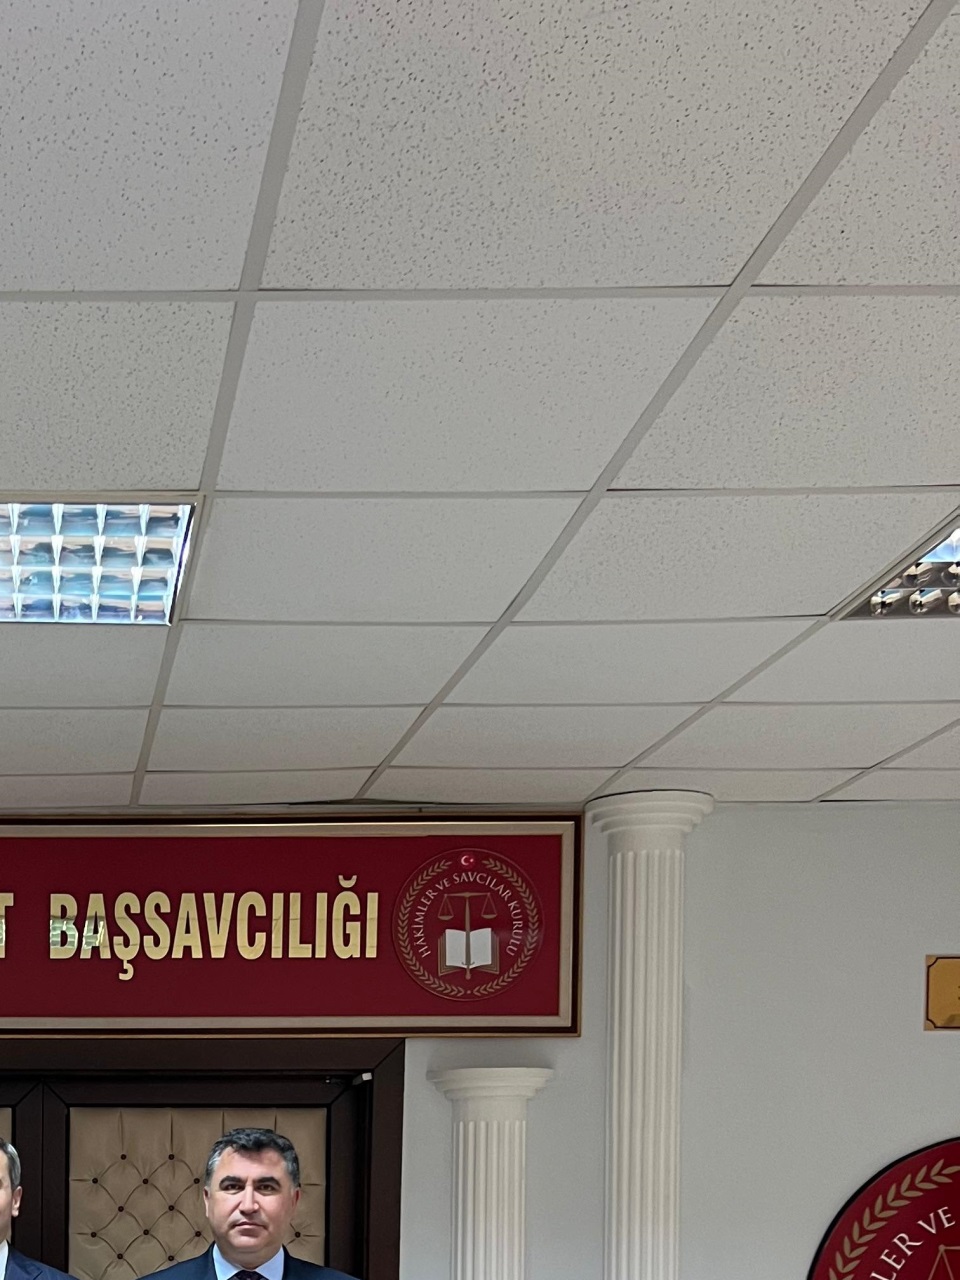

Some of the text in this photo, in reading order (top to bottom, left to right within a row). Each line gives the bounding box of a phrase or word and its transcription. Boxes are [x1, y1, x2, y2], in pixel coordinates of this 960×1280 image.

[49, 874, 379, 981] BAŞSAVCILIĞI
[436, 878, 451, 890] VE
[452, 871, 512, 901] SAVCILAR
[505, 900, 524, 956] KURULU
[916, 1206, 956, 1235] VE
